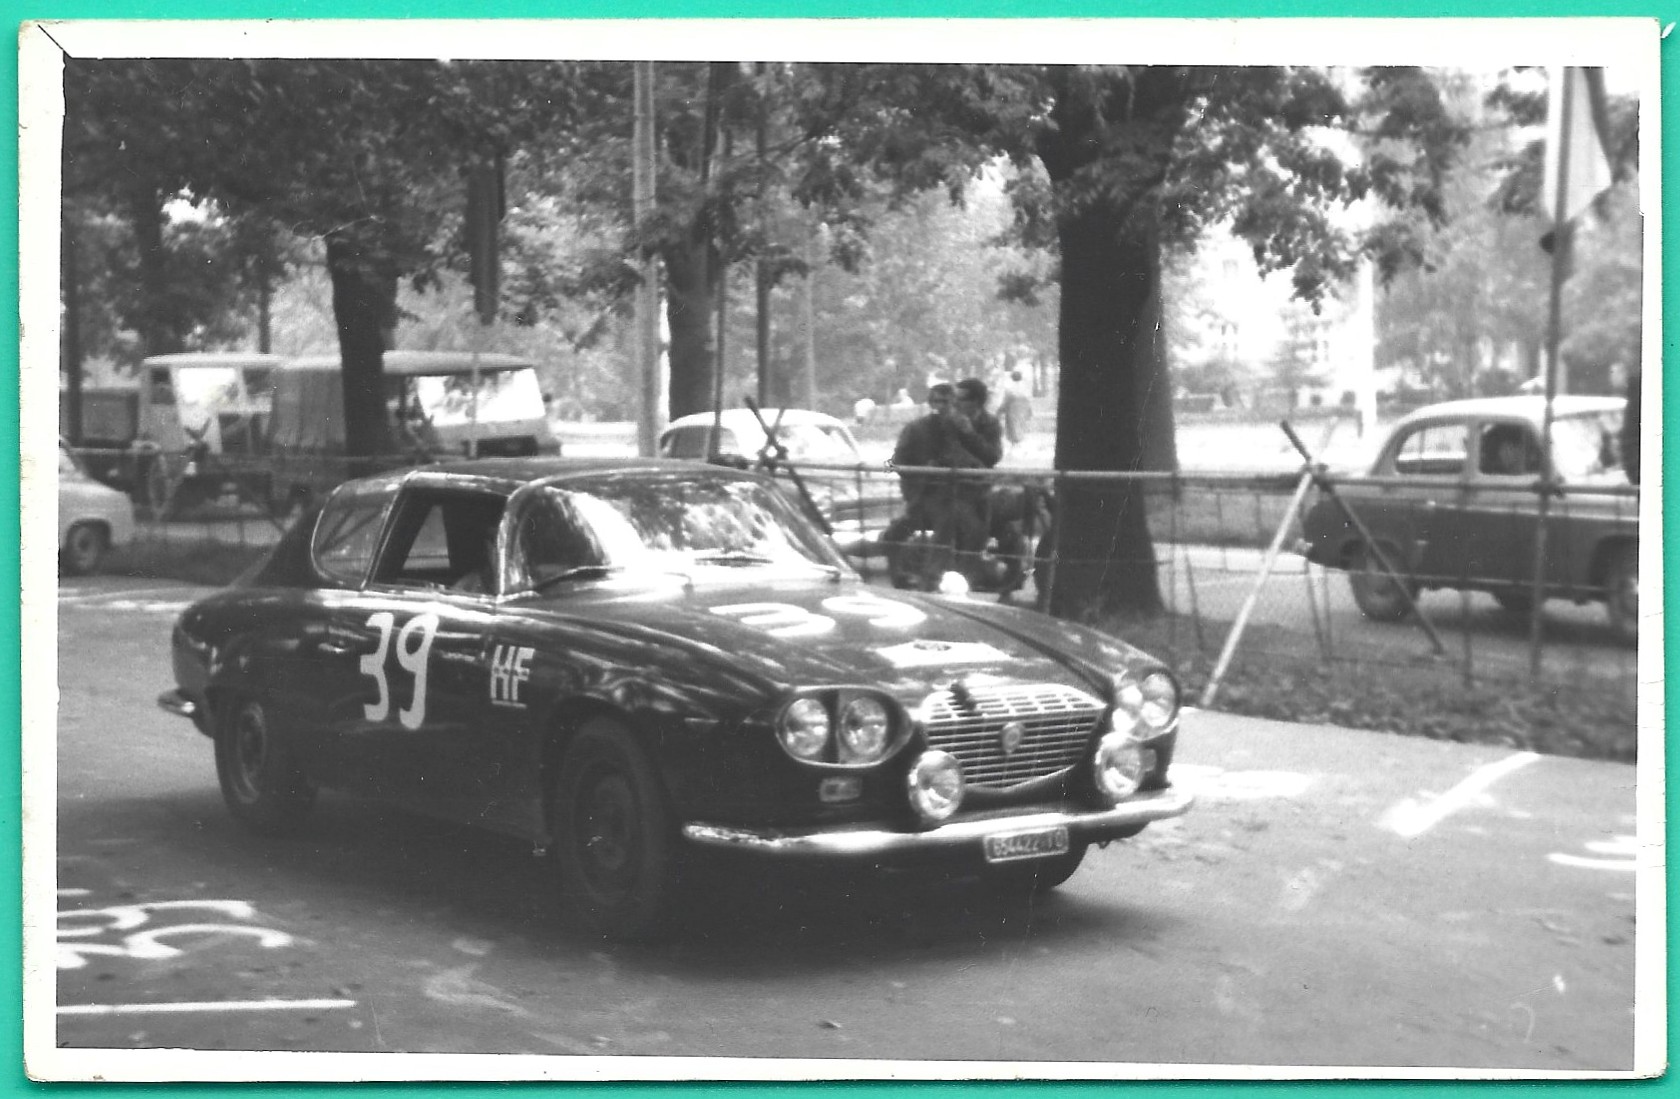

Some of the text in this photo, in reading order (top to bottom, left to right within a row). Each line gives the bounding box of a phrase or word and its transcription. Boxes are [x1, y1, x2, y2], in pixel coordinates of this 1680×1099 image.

[709, 591, 927, 637] 39
[360, 612, 440, 729] 39
[490, 645, 536, 702] HF
